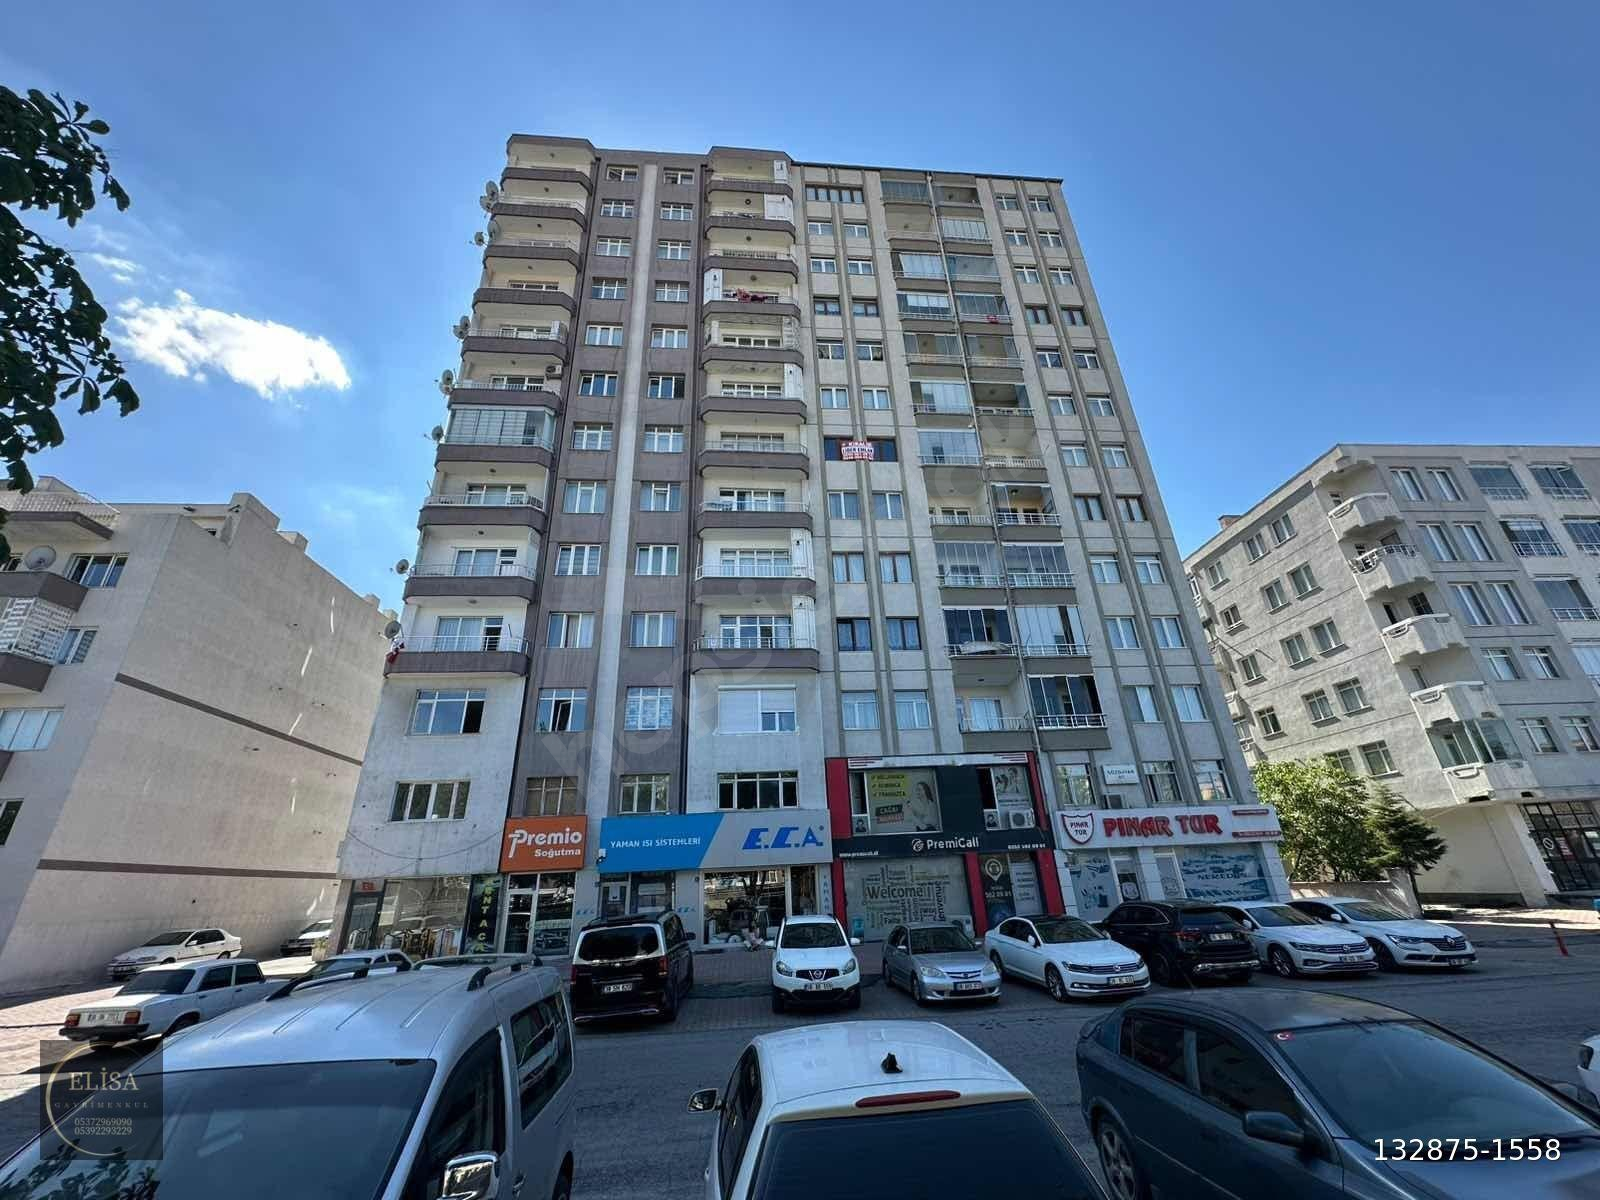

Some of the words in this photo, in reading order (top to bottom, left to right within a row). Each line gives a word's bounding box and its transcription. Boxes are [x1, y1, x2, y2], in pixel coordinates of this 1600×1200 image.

[1176, 814, 1223, 835] TUR
[508, 827, 582, 858] Premio
[610, 840, 640, 849] YAMAN
[926, 837, 979, 850] PremiCall
[534, 847, 582, 859] Soğutma
[866, 885, 923, 899] Welcome
